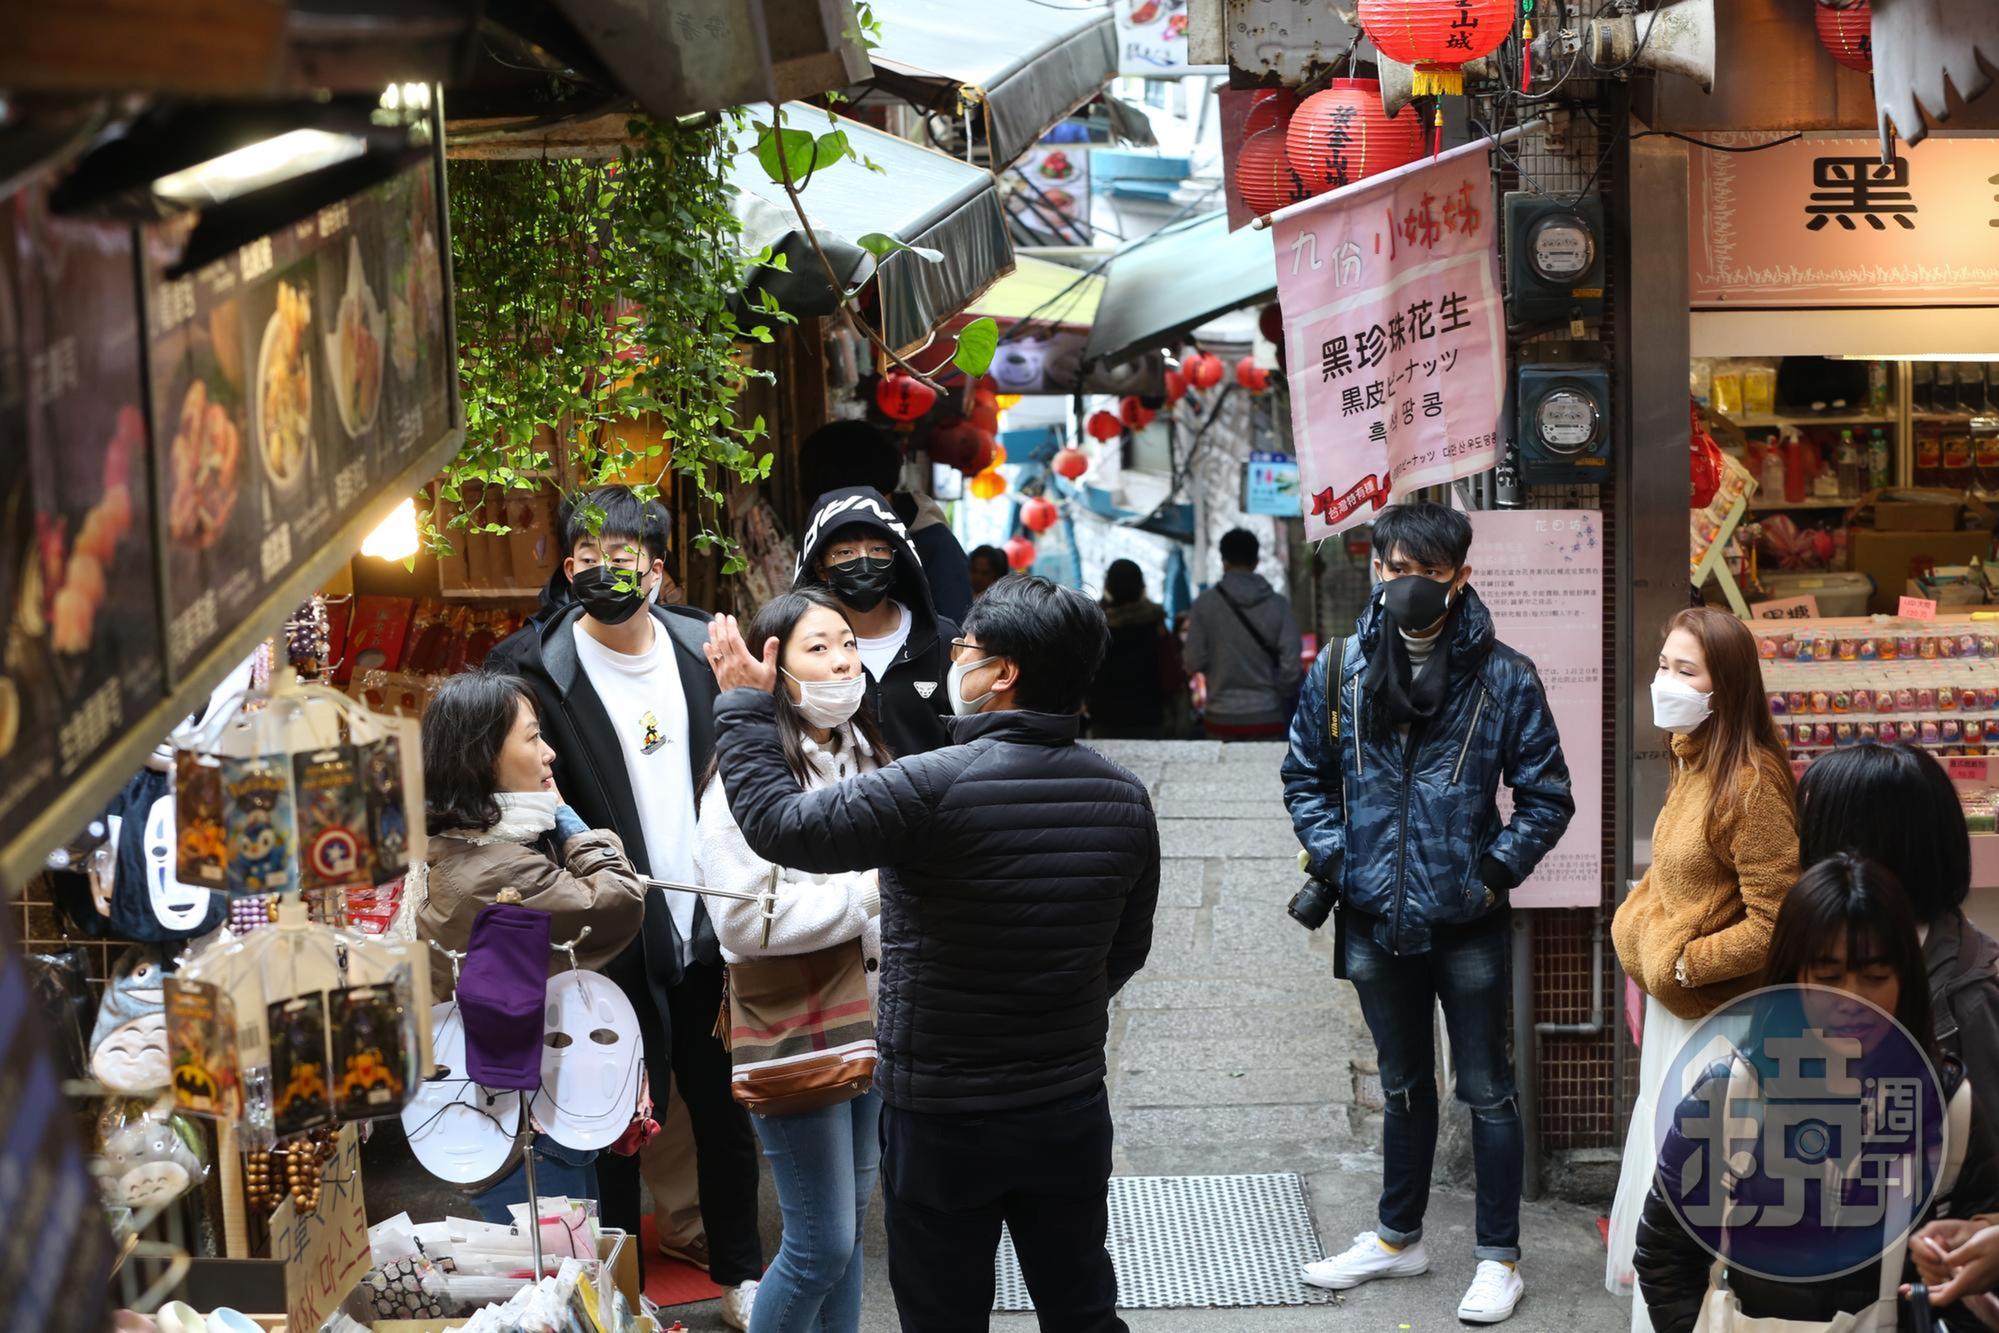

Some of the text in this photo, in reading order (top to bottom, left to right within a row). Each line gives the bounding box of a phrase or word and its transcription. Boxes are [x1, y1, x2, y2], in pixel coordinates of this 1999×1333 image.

[1321, 292, 1472, 383] 黑珍珠花生
[1331, 710, 1339, 738] Nikon
